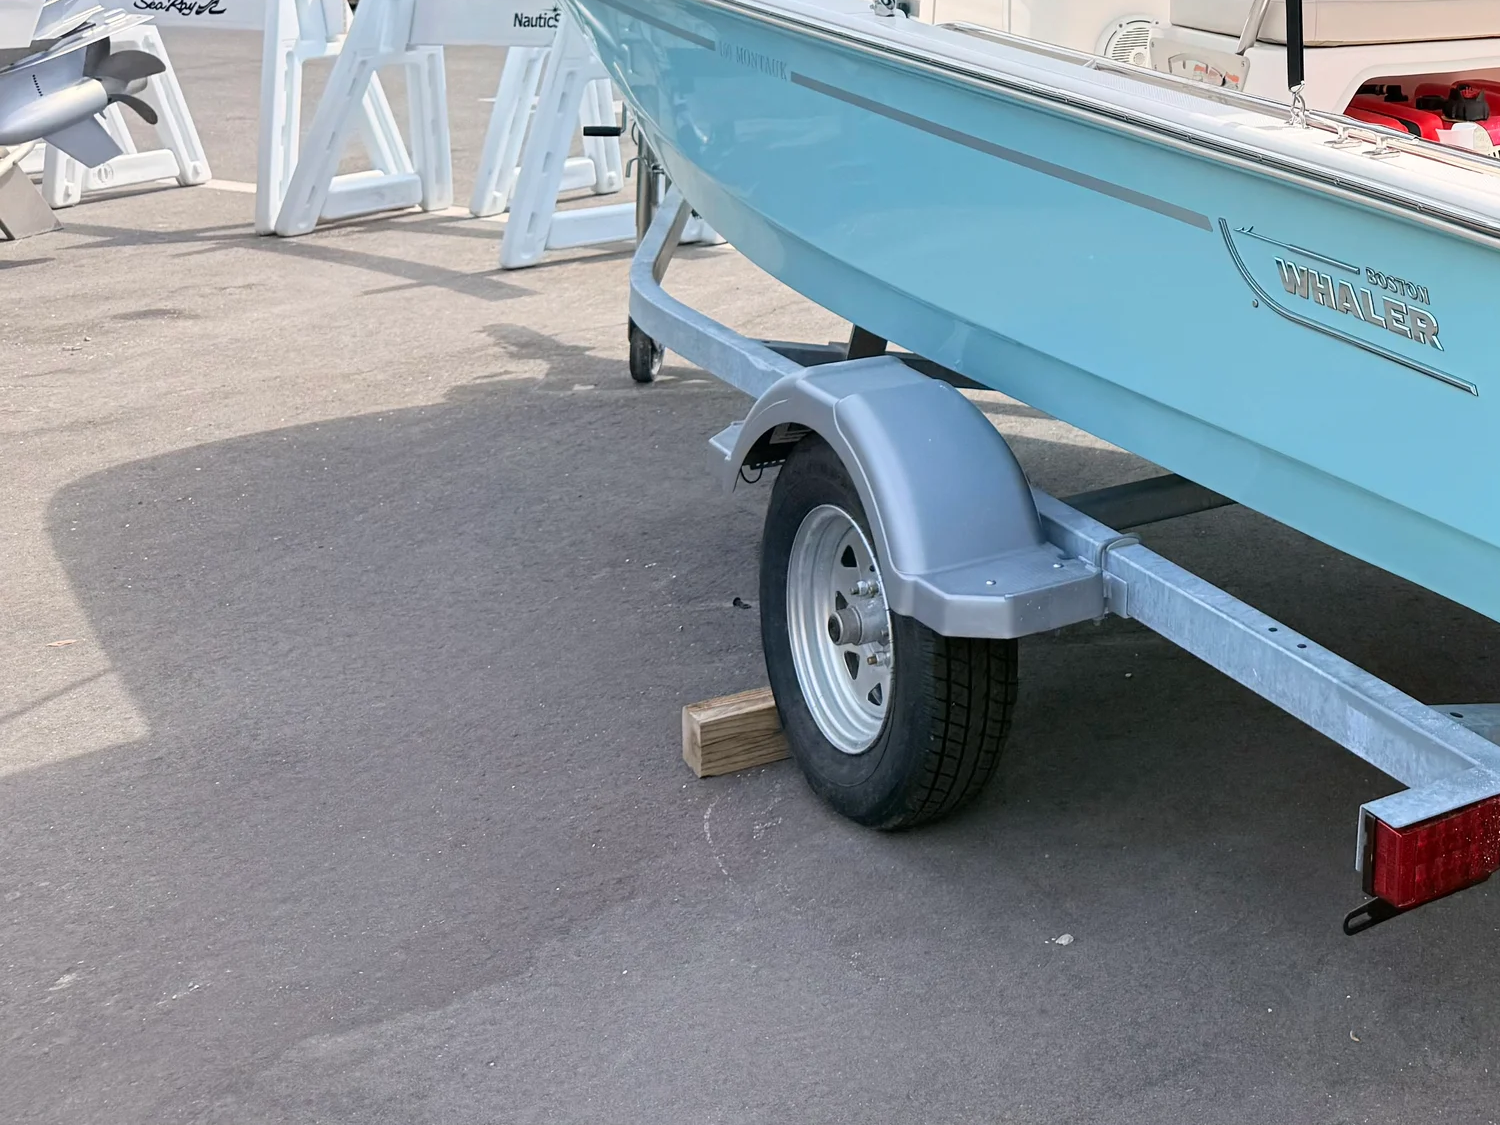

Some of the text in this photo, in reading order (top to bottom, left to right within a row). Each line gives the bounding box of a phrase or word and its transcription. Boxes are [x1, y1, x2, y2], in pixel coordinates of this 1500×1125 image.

[736, 45, 788, 81] MONTAUK
[1274, 256, 1444, 351] WHALER
[1366, 266, 1430, 305] BOSTON
